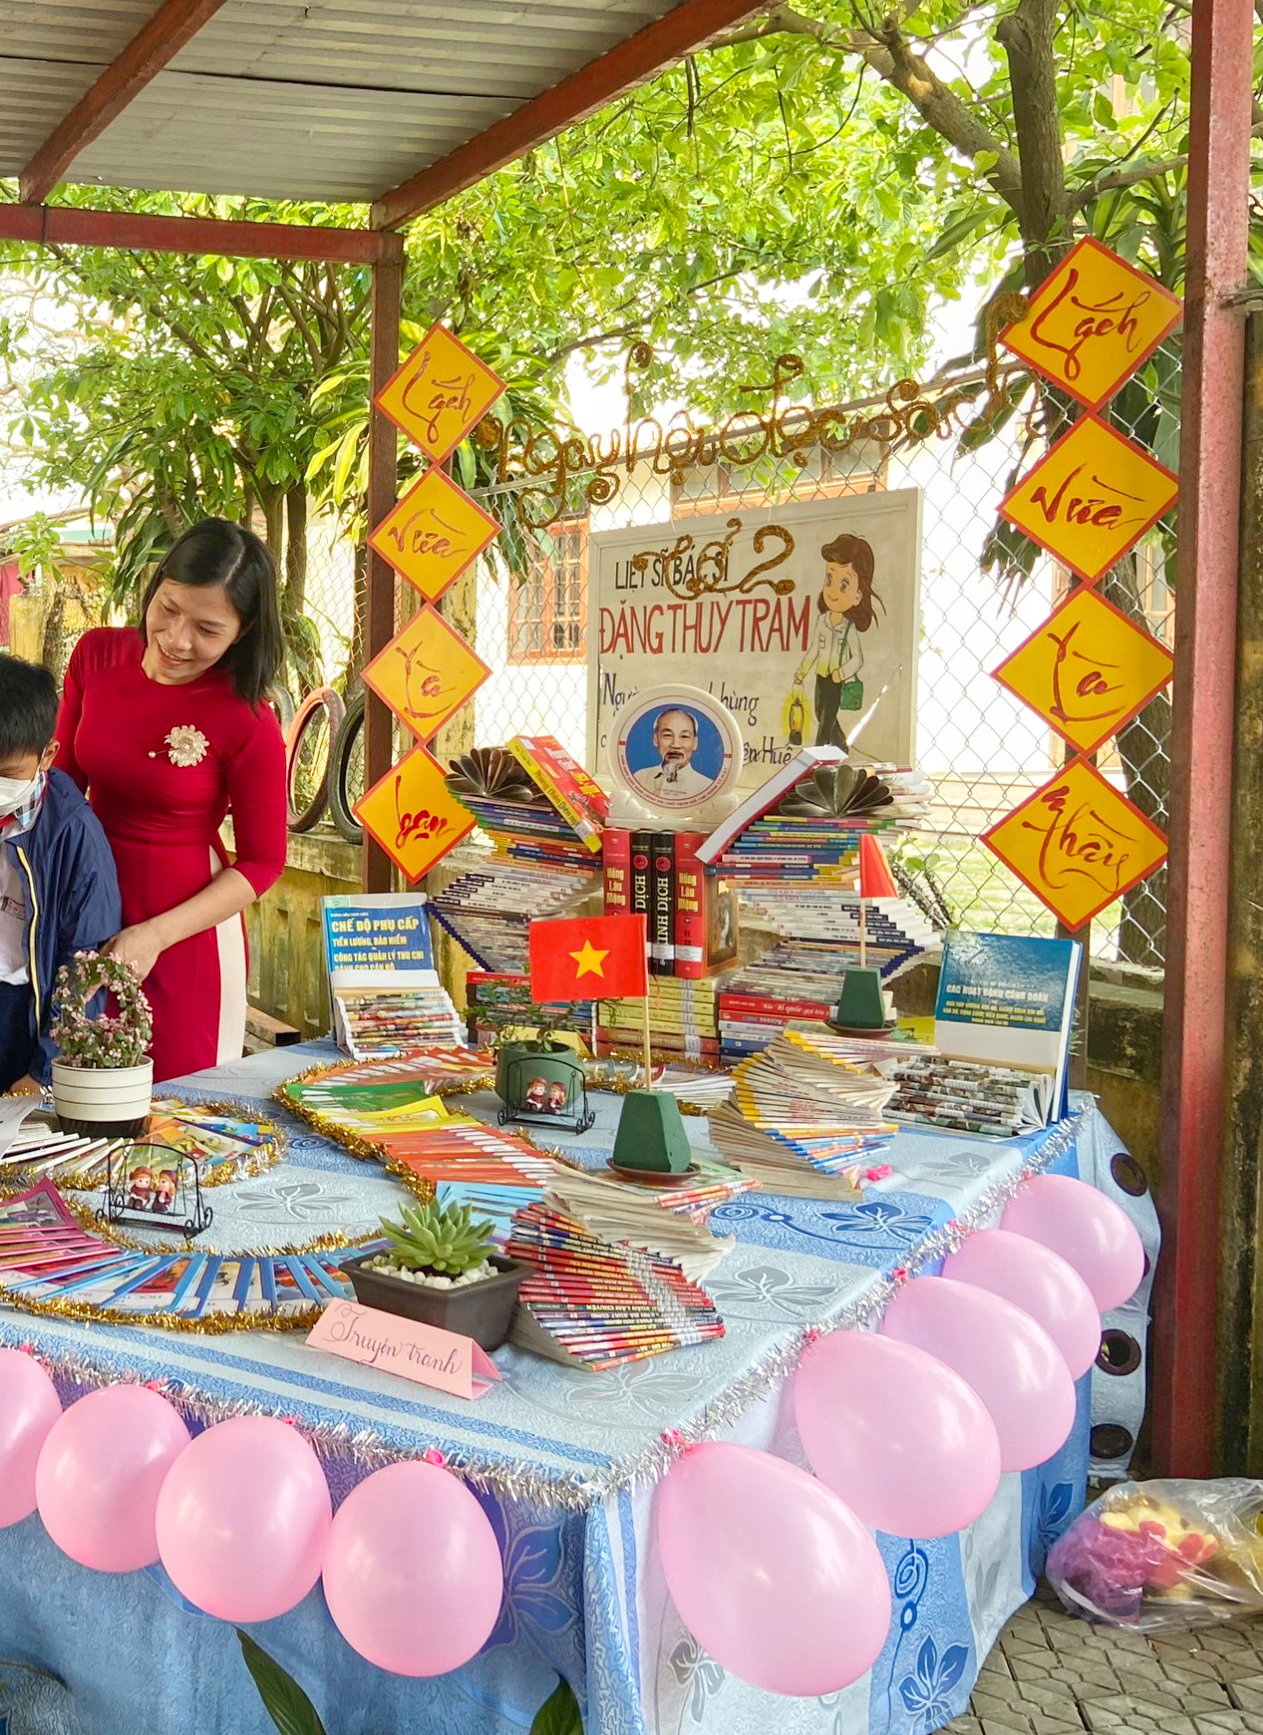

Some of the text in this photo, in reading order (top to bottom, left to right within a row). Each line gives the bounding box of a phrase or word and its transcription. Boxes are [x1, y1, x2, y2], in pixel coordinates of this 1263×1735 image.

[599, 599, 664, 660] ĐẶNG
[635, 875, 649, 909] DỊCH
[657, 877, 672, 912] DỊCH
[331, 917, 354, 932] CHẾ
[373, 919, 395, 933] PHỤ
[397, 915, 419, 930] CẤP
[404, 1342, 463, 1374] tranh
